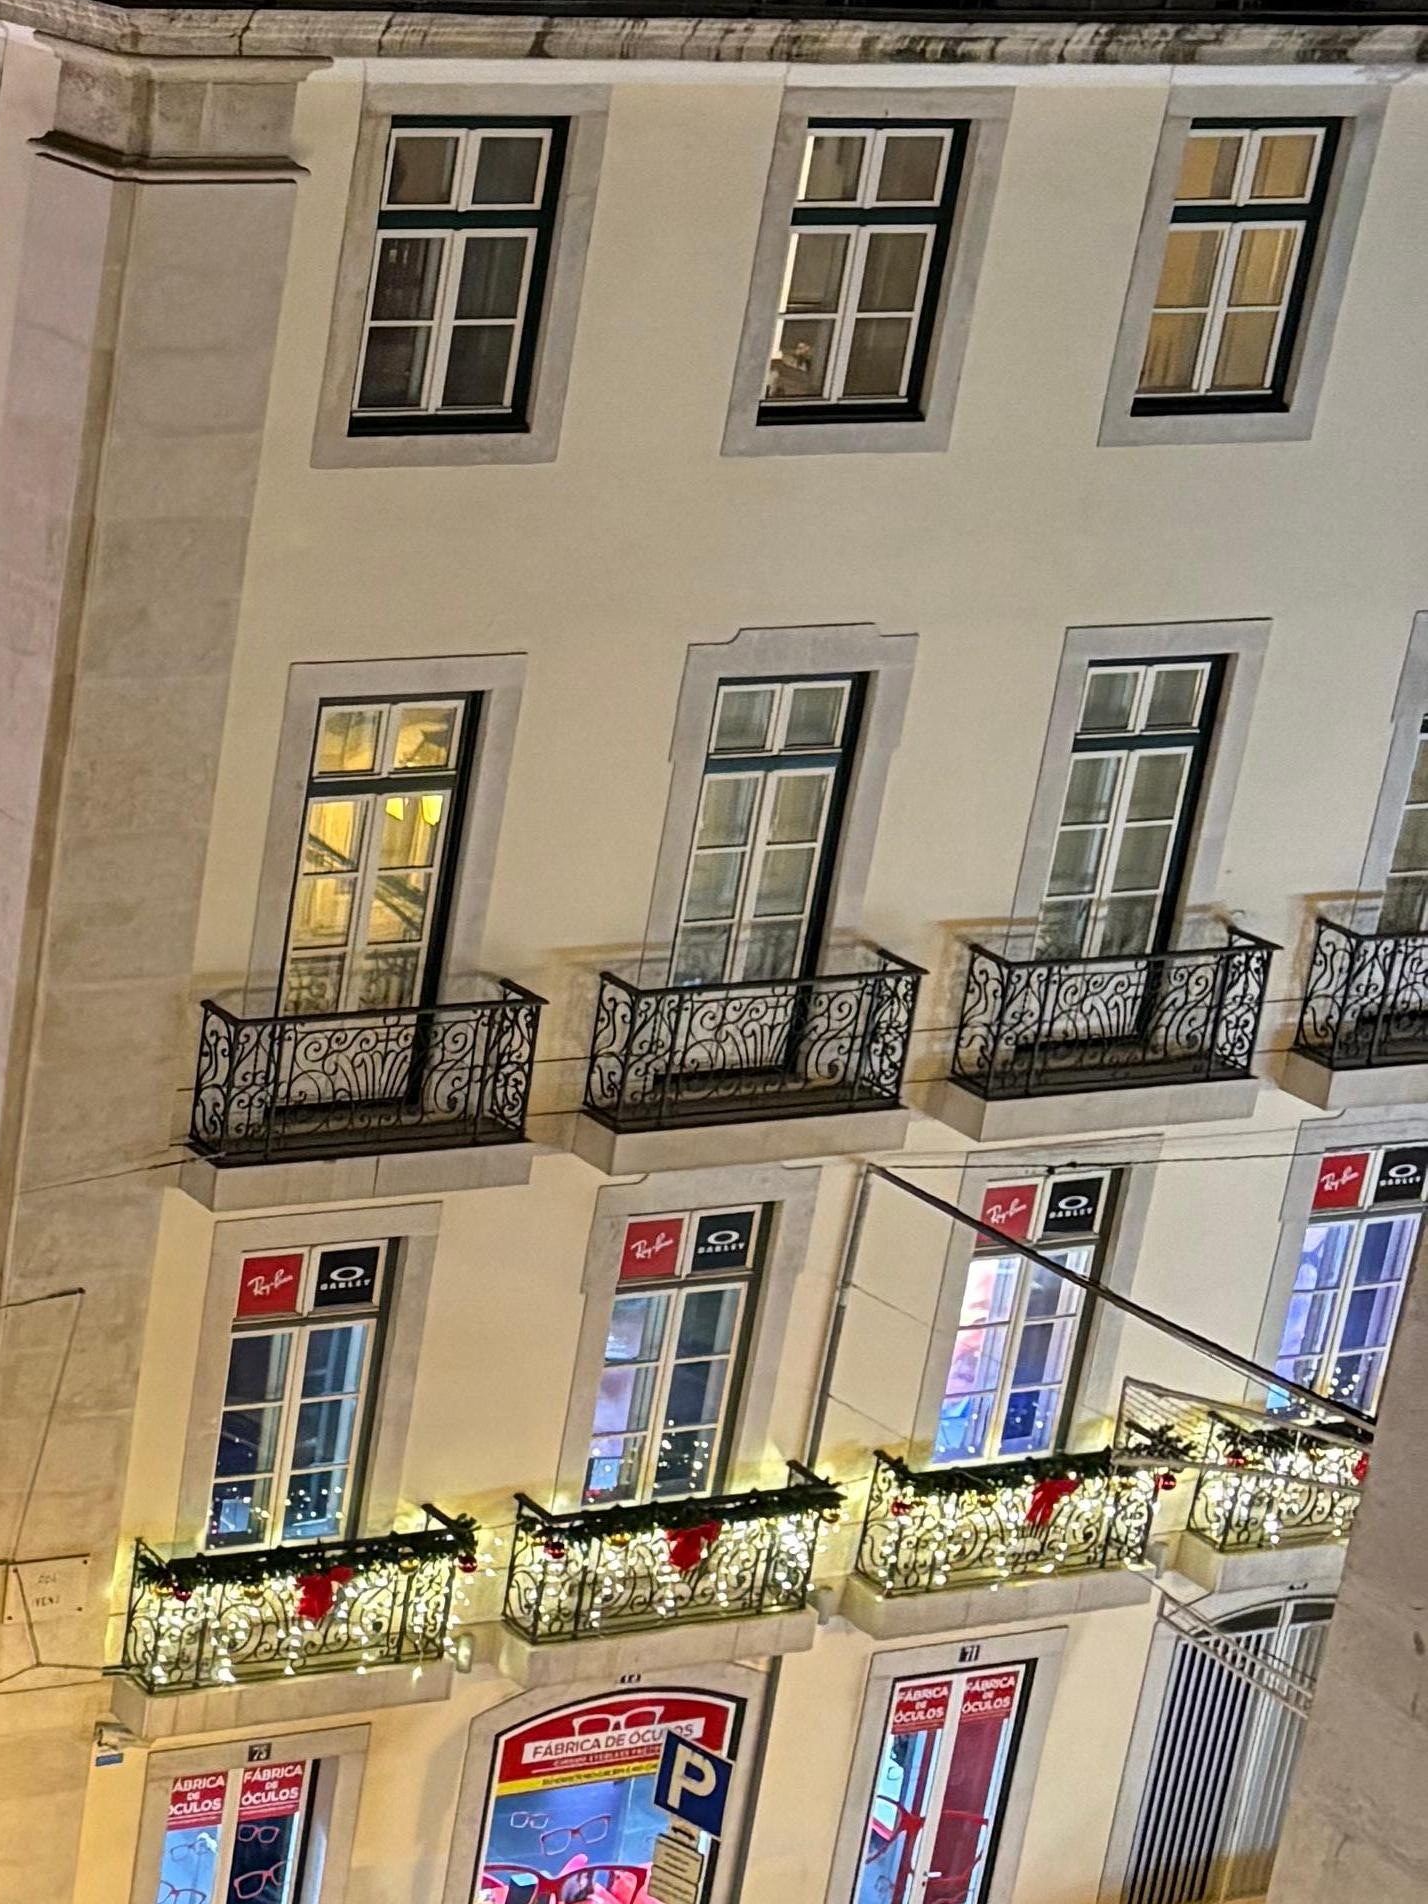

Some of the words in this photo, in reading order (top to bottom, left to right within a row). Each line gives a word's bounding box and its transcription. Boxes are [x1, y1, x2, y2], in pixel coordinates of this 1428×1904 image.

[246, 1268, 294, 1297] Ray-Ban
[967, 1675, 1016, 1693] FÁBRICA
[898, 1686, 950, 1703] FÁBRICA
[961, 1696, 1011, 1715] ÓCULOS
[895, 1706, 945, 1724] ÓCULOS
[532, 1737, 602, 1760] FÁBRICA
[604, 1732, 626, 1747] DE
[628, 1723, 695, 1746] ÓCUOS
[243, 1764, 304, 1784] FÁBRICA
[666, 1742, 717, 1810] P
[172, 1775, 225, 1793] ÁBRICA
[264, 1780, 279, 1790] DE
[186, 1791, 201, 1801] DE
[241, 1786, 300, 1806] ÓCULOS
